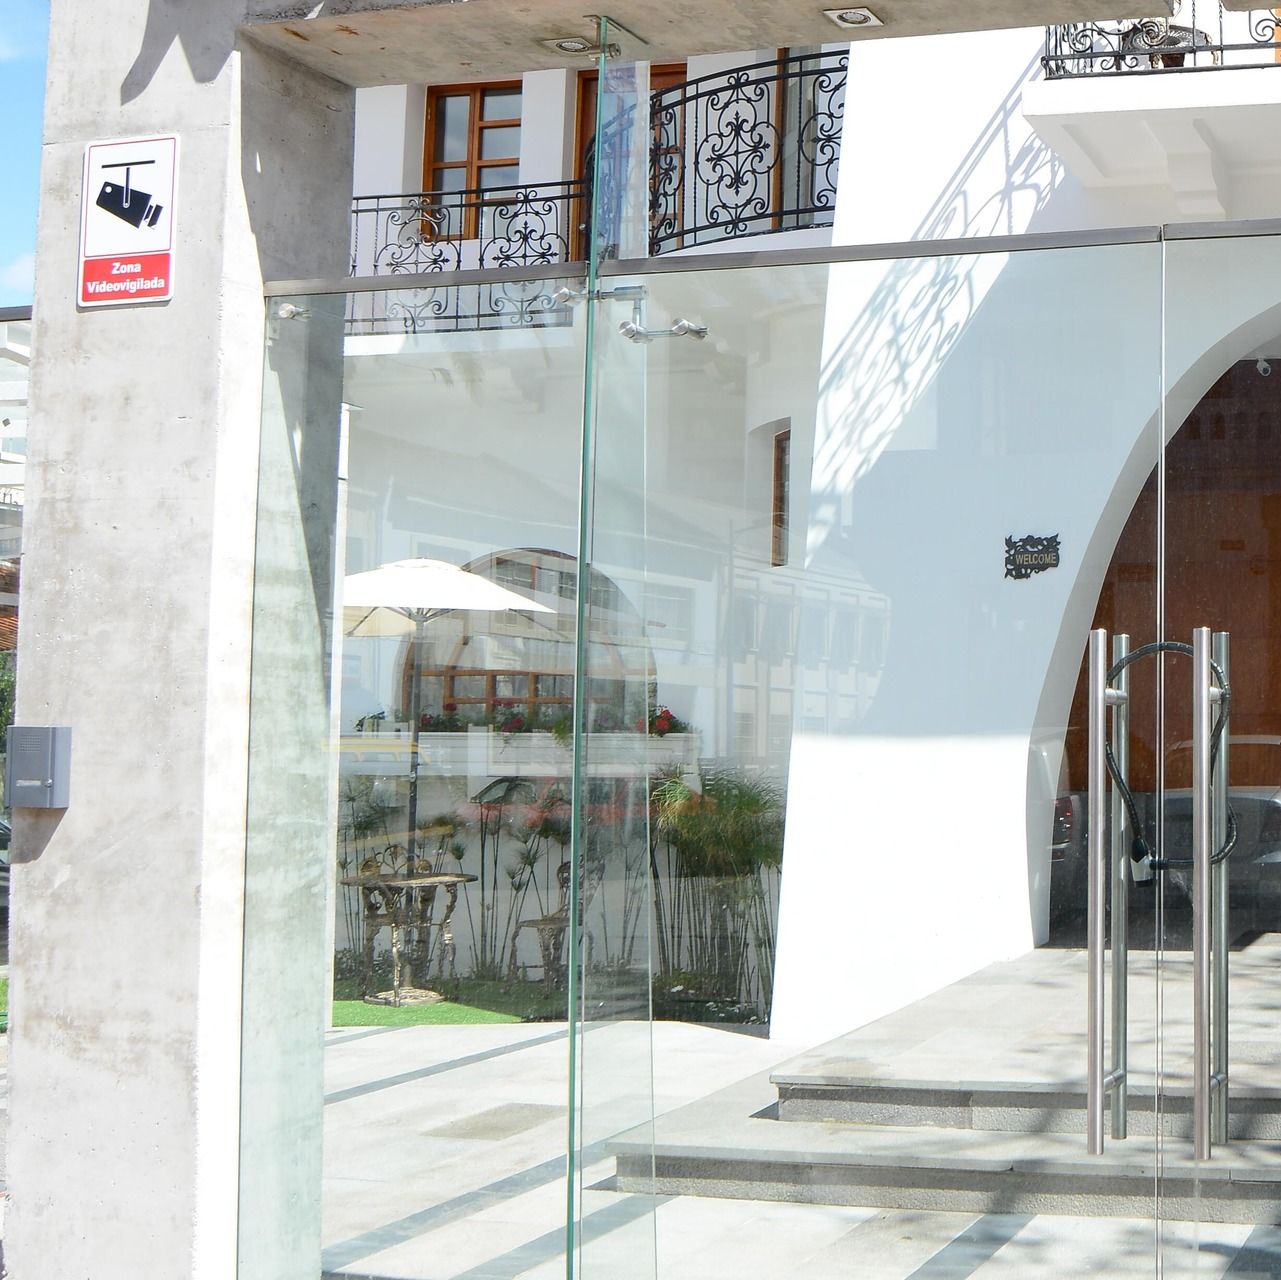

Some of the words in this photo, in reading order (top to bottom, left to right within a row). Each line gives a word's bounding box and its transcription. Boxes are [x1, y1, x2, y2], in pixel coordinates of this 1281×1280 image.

[112, 263, 141, 274] Zona
[87, 278, 165, 293] Videovigilada
[1016, 553, 1056, 564] WELCOME
